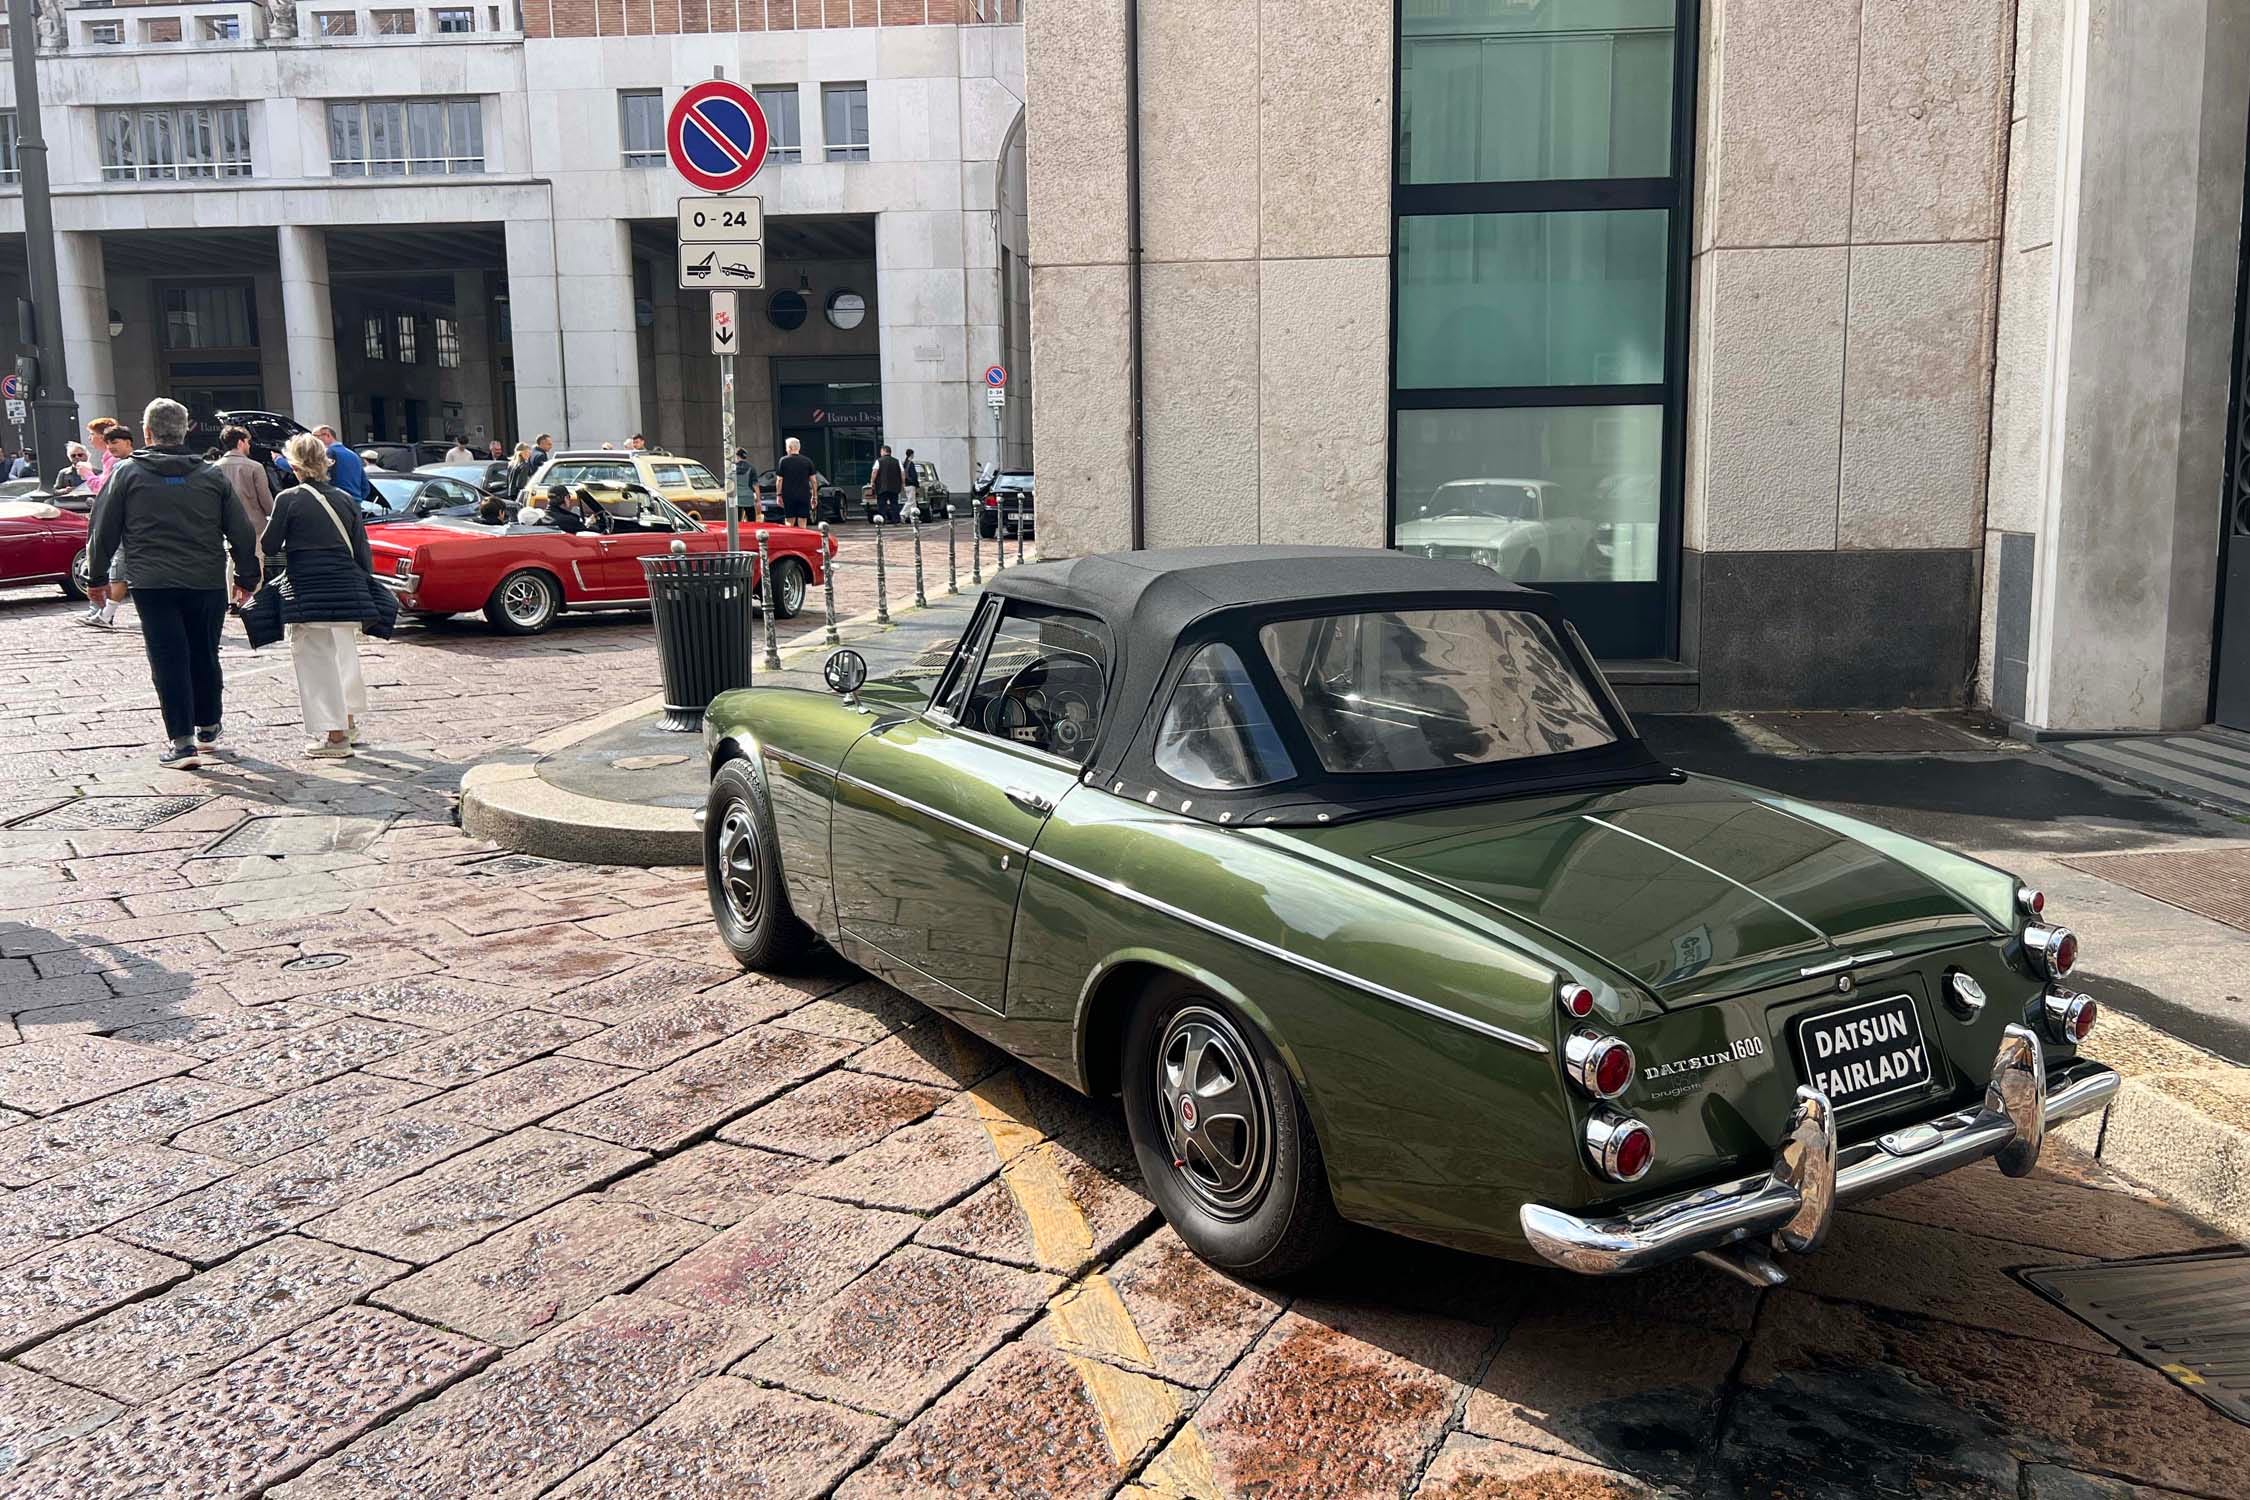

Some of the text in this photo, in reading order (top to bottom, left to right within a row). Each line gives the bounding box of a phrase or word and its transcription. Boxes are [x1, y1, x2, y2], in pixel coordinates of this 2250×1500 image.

[694, 211, 705, 227] 0
[722, 211, 747, 227] 24
[827, 412, 857, 422] Banco
[1815, 1010, 1908, 1058] DATSUN
[1644, 1036, 1764, 1080] DATSUN 1600
[1815, 1045, 1921, 1098] FAIRLADY
